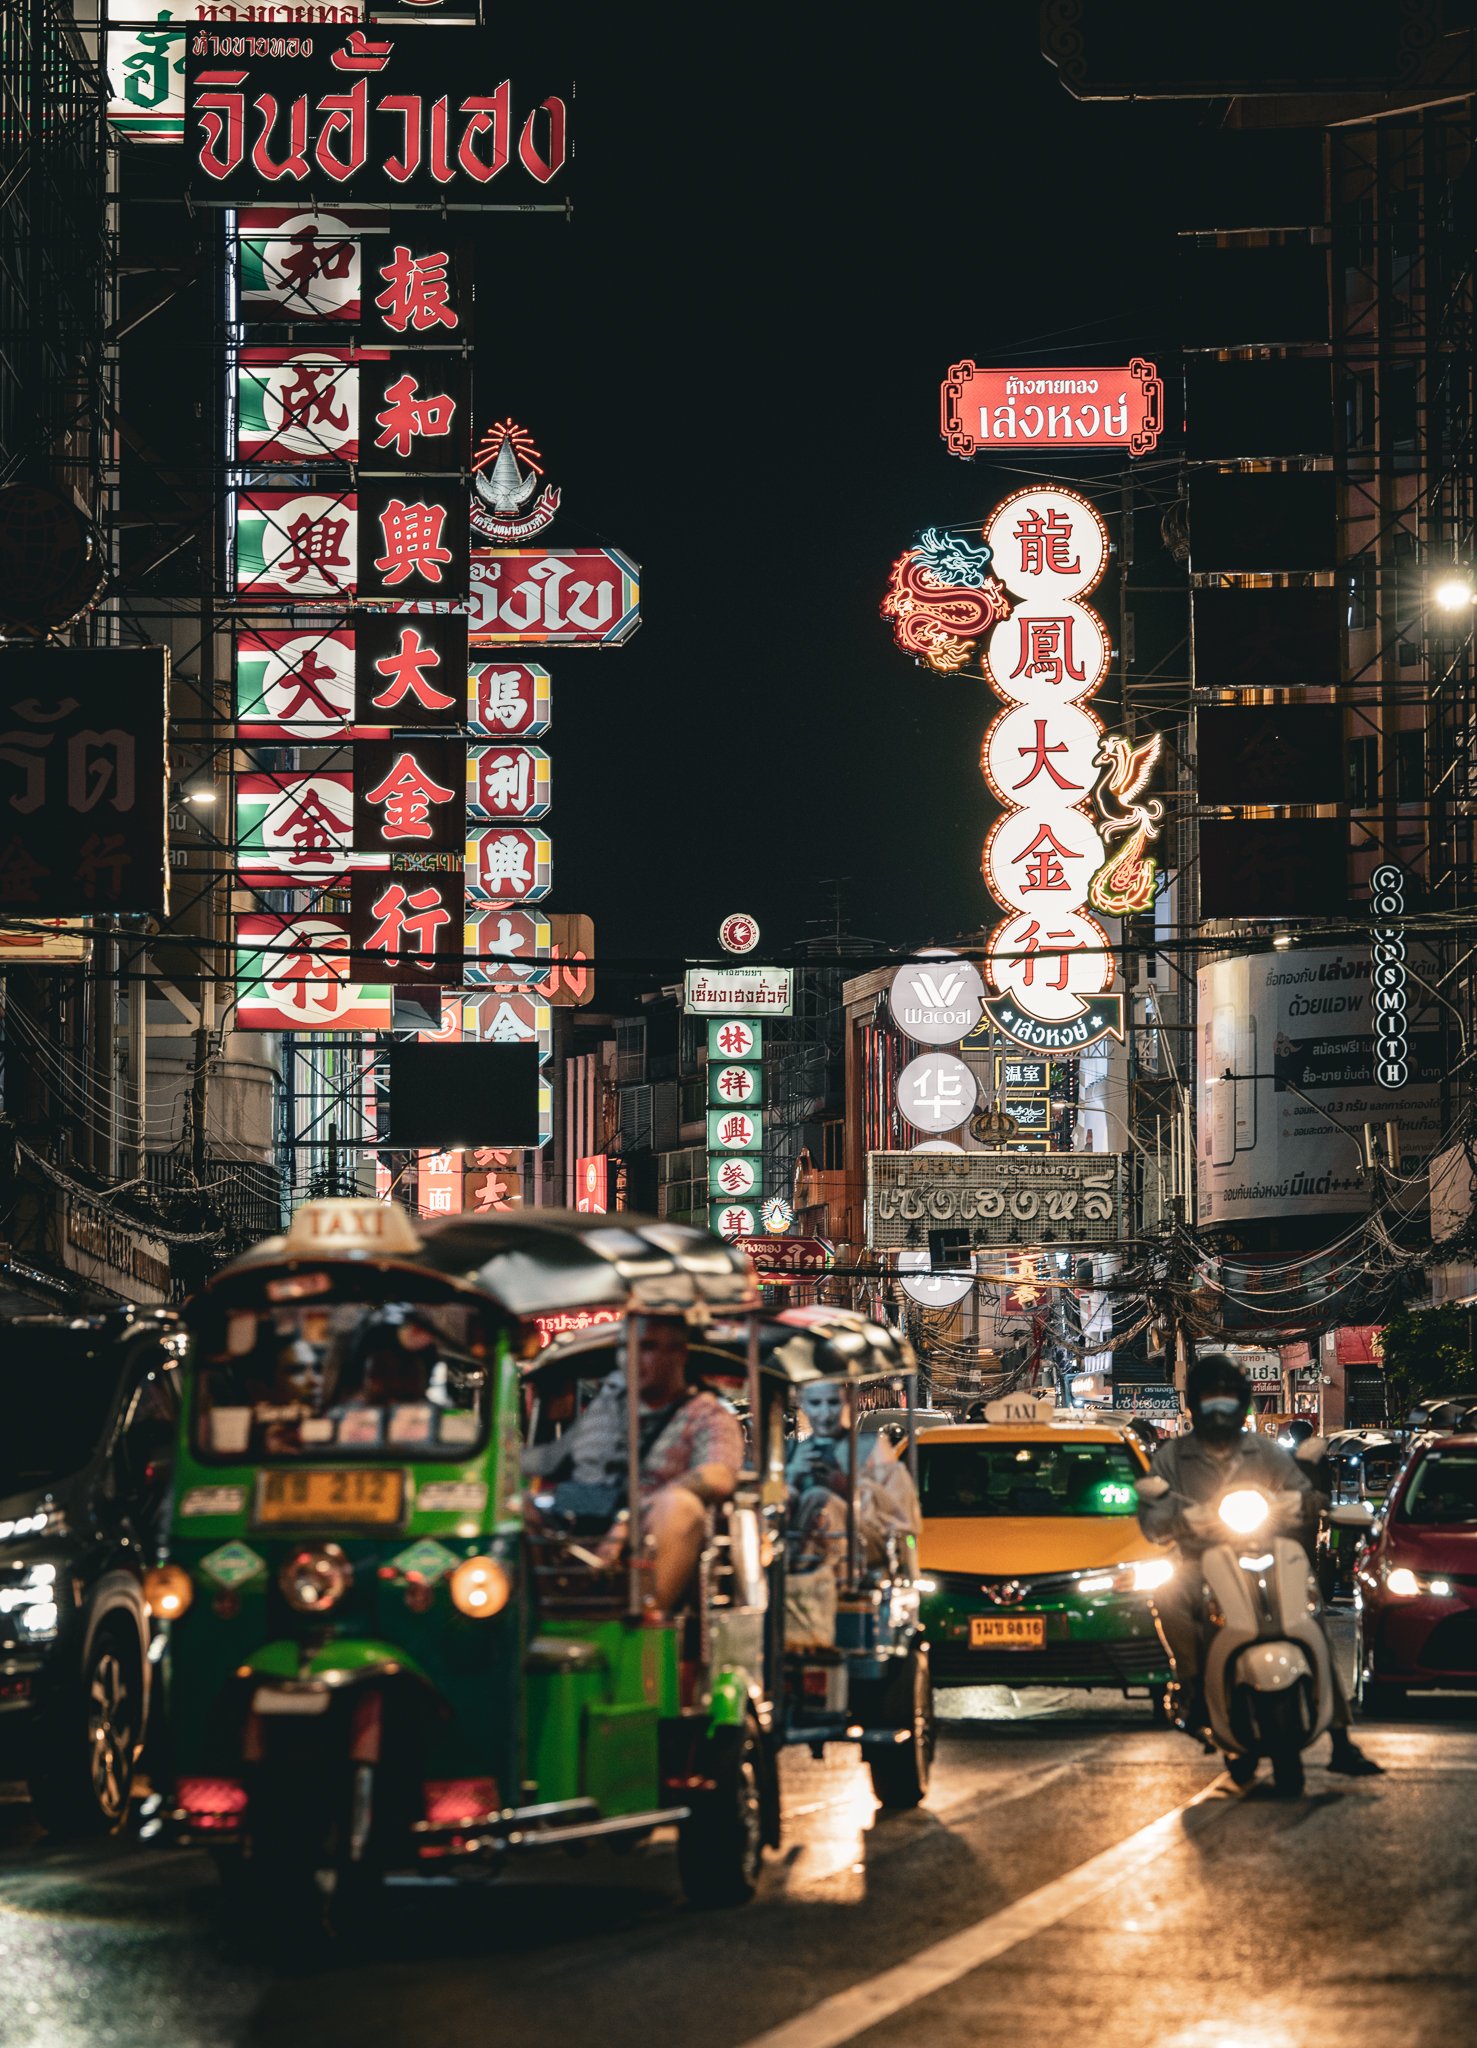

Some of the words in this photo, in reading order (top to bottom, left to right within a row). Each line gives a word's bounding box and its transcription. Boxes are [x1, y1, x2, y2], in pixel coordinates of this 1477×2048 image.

[192, 29, 313, 58] ห้างขายทอง
[194, 30, 567, 183] จินฮั้วเฮง
[1005, 375, 1099, 395] ห้างขายทอง
[979, 392, 1129, 439] เล่งหงษ์
[1009, 508, 1087, 990] 龍鳳大金行
[904, 1008, 971, 1024] Wacoal
[1011, 1016, 1088, 1047] เล่งหงษ์
[913, 1158, 970, 1174] ทอง
[310, 1209, 385, 1237] TAXI
[1002, 1402, 1038, 1421] TAXI
